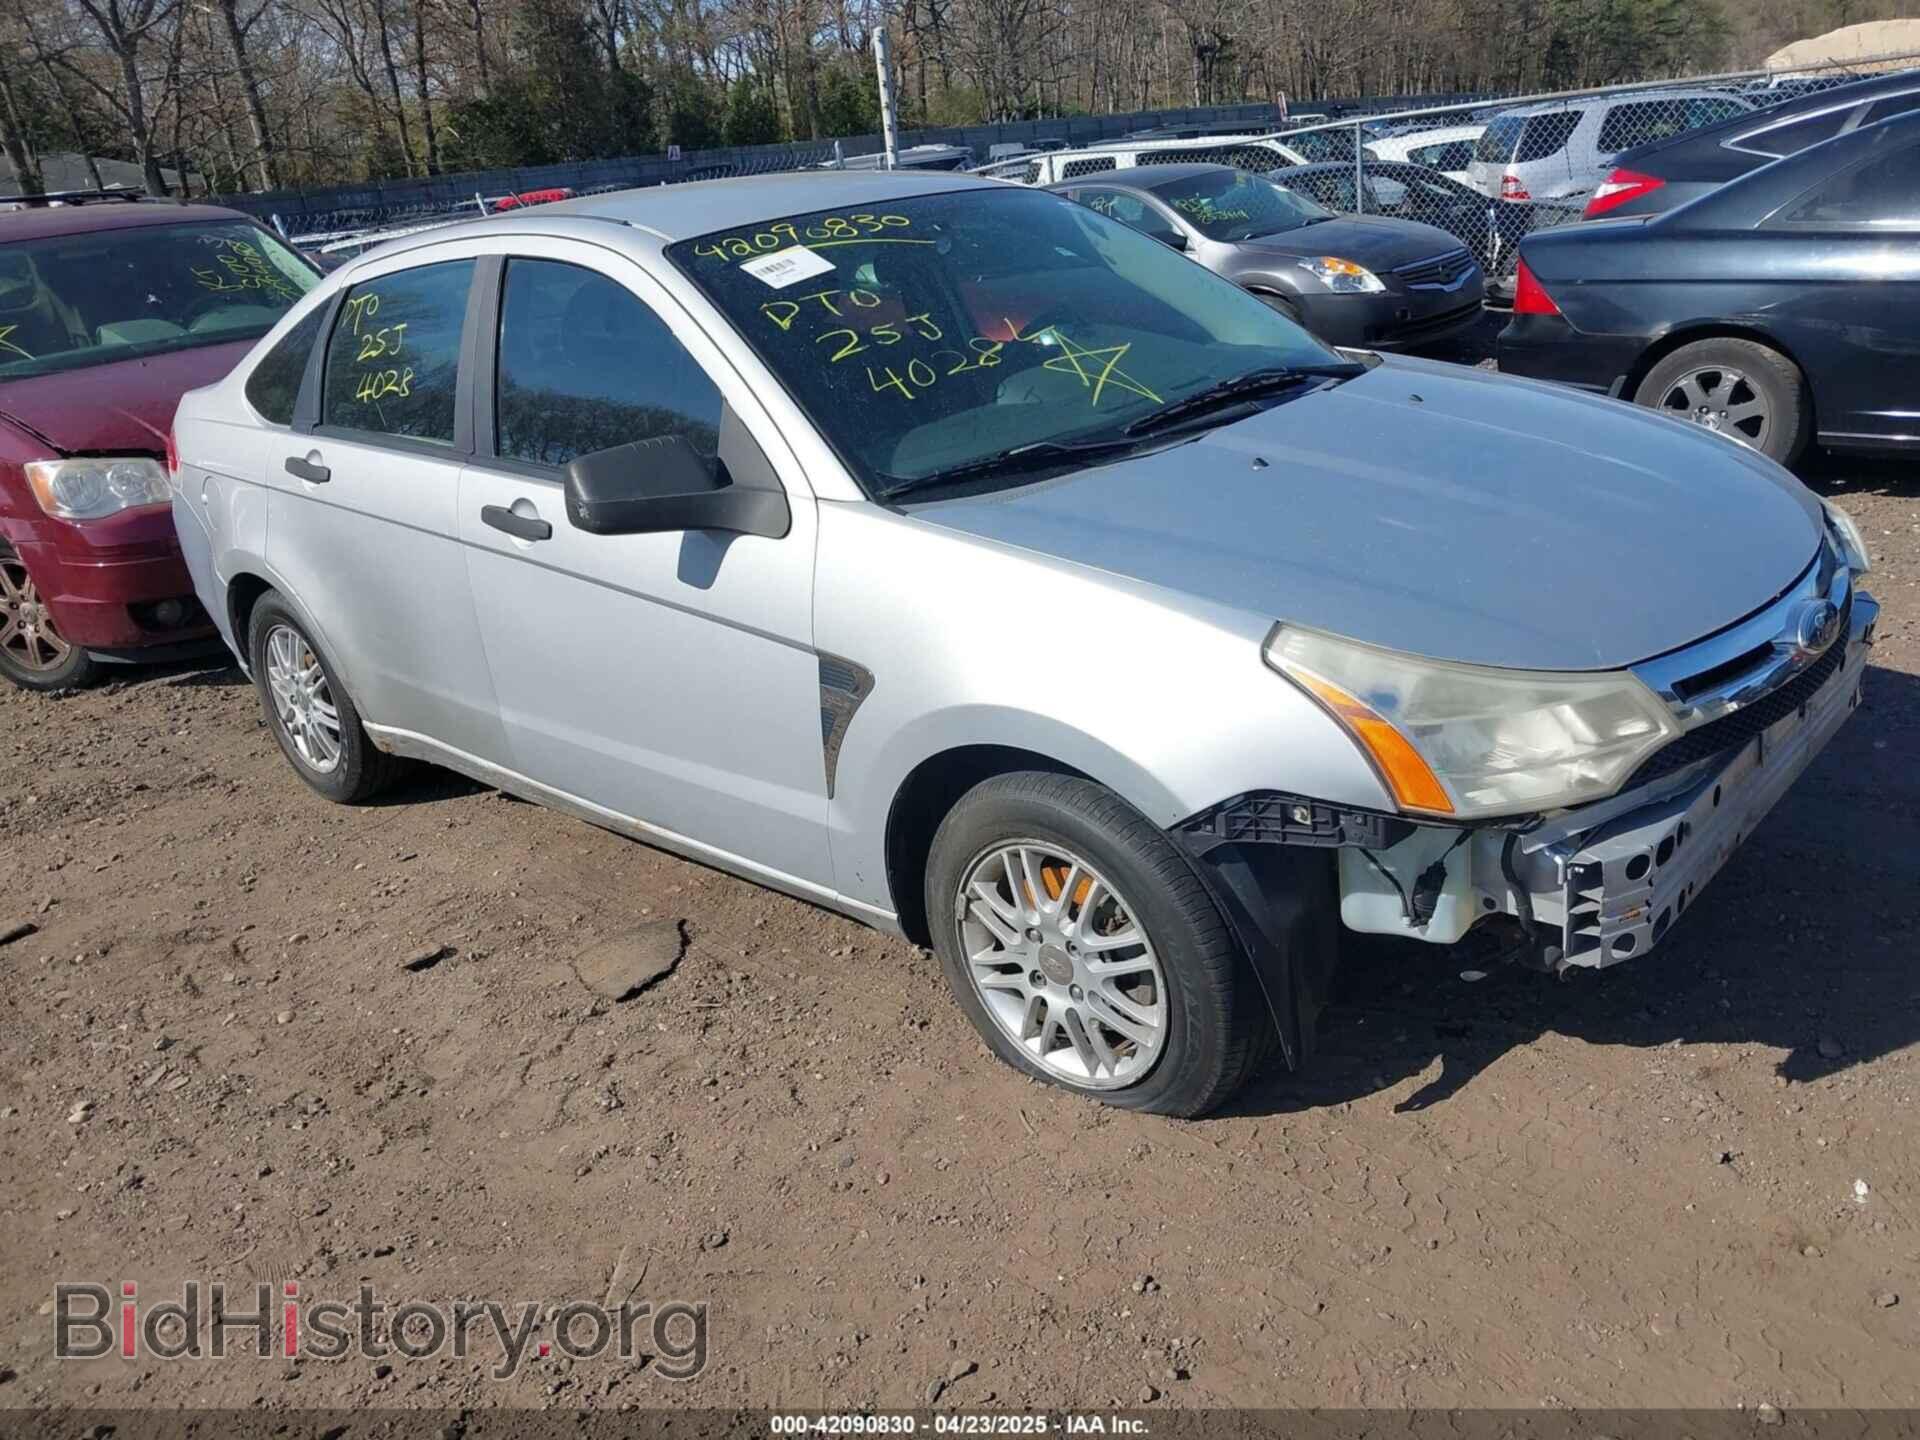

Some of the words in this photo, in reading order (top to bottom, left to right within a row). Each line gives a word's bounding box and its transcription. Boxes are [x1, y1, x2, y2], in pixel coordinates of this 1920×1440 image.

[694, 214, 911, 262] 42090830
[356, 323, 408, 361] 25J
[815, 313, 942, 362] 25J
[356, 367, 414, 403] 4028
[866, 336, 1004, 399] 4028
